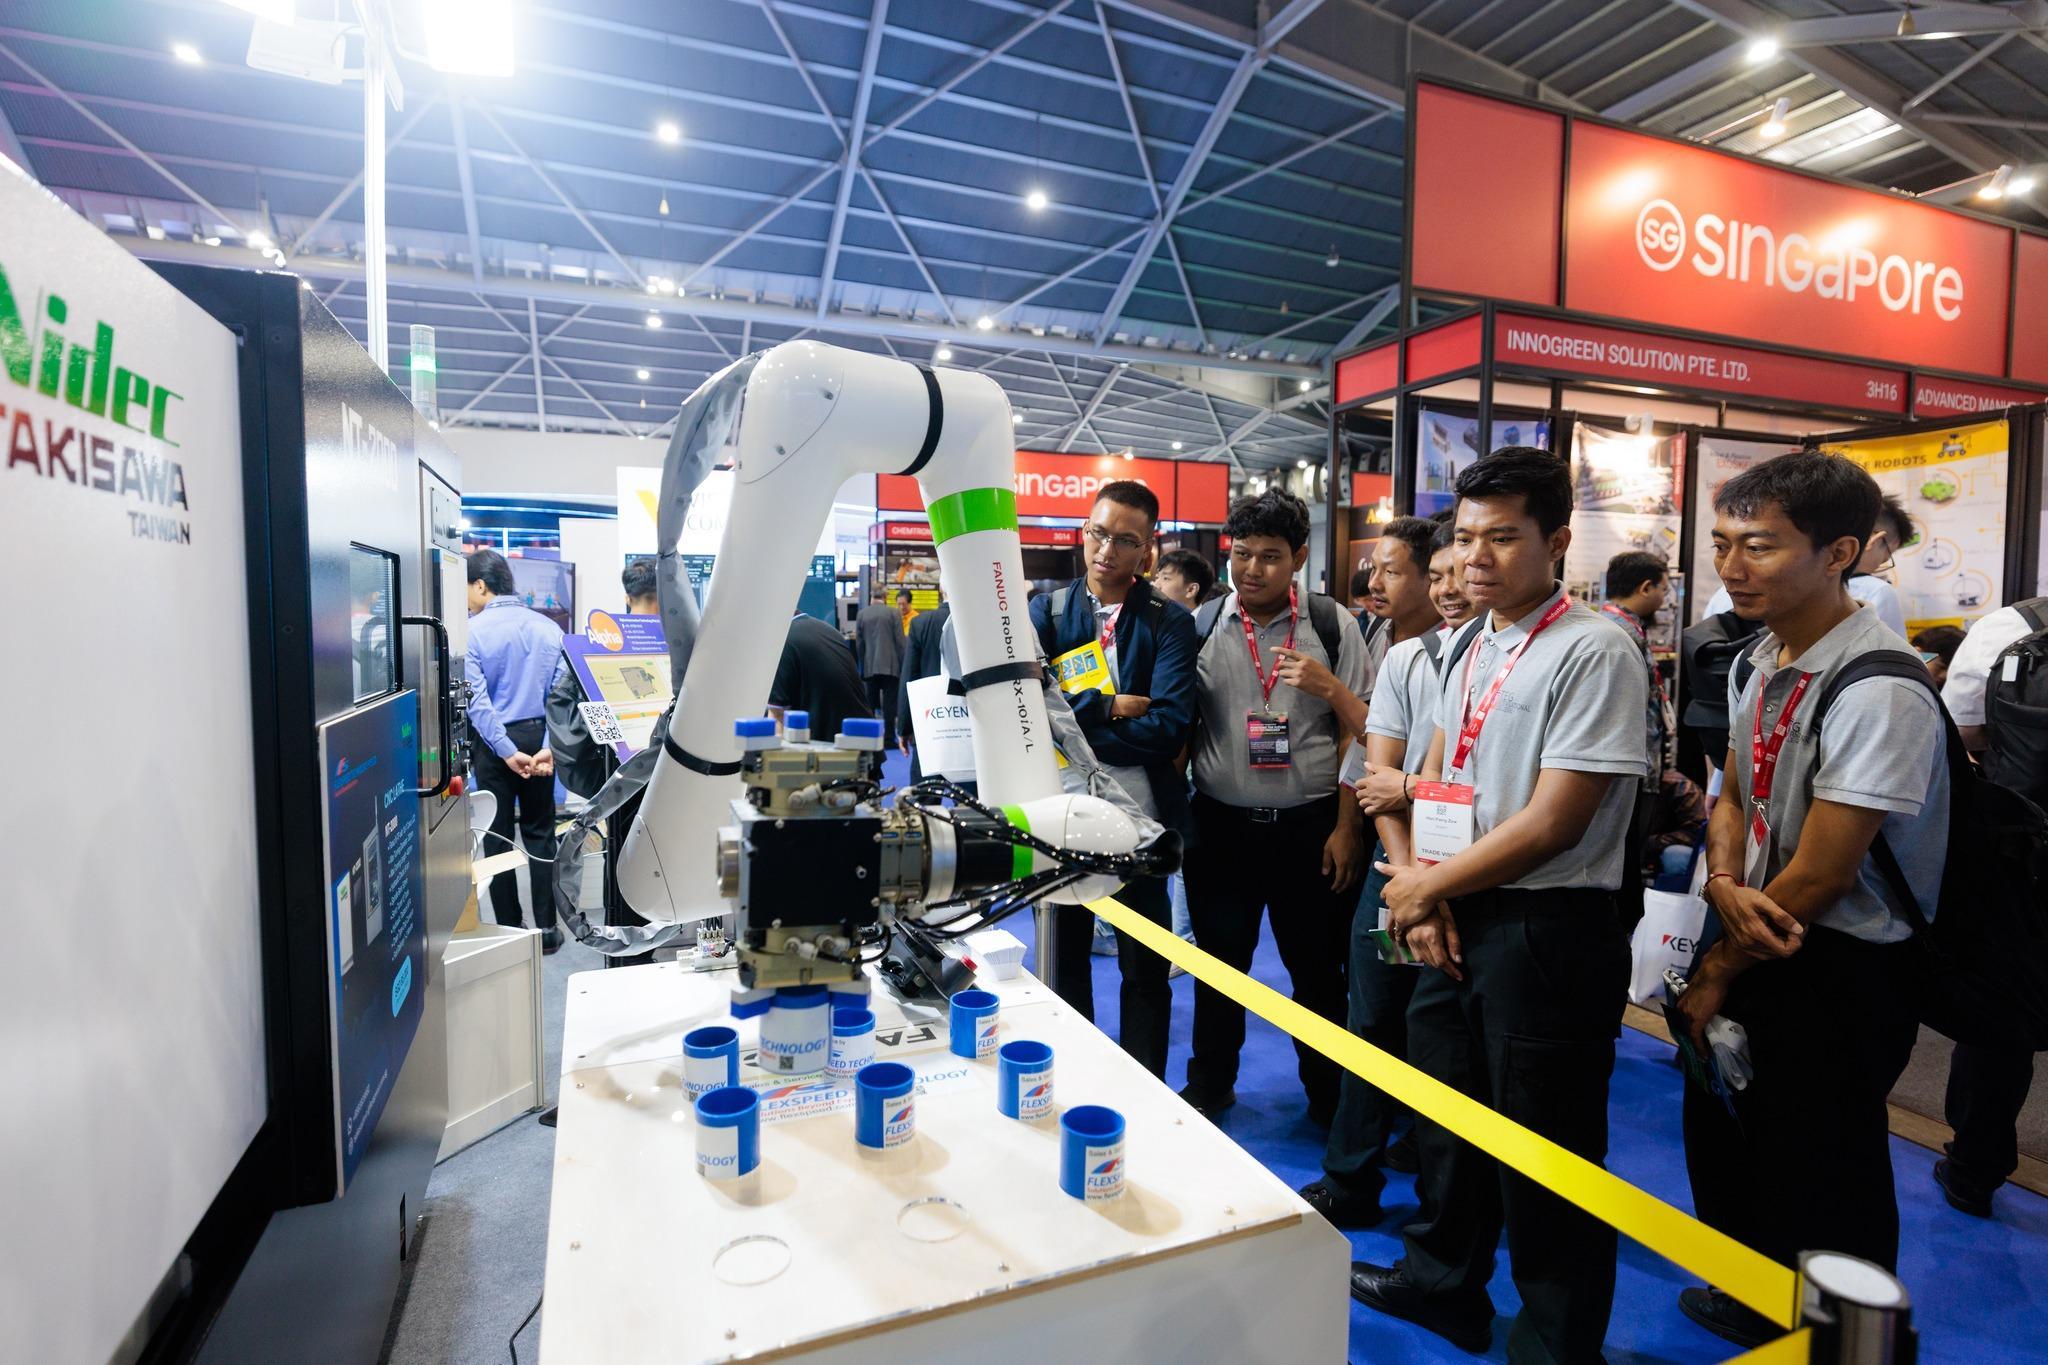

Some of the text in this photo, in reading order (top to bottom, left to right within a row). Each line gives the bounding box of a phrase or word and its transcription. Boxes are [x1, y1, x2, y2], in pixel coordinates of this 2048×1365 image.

[1507, 329, 1898, 402] INNOGREEN SOLUTION PTE. LTD. 3H16
[1916, 388, 1977, 412] ADVANCED
[0, 404, 189, 511] AKISAWA
[1874, 454, 1927, 470] ROBOTS
[127, 510, 191, 546] TAIWAN
[993, 561, 1008, 612] FANUC
[1001, 616, 1016, 660] Robot
[587, 628, 623, 646] Alpha
[1422, 848, 1440, 856] TRADE
